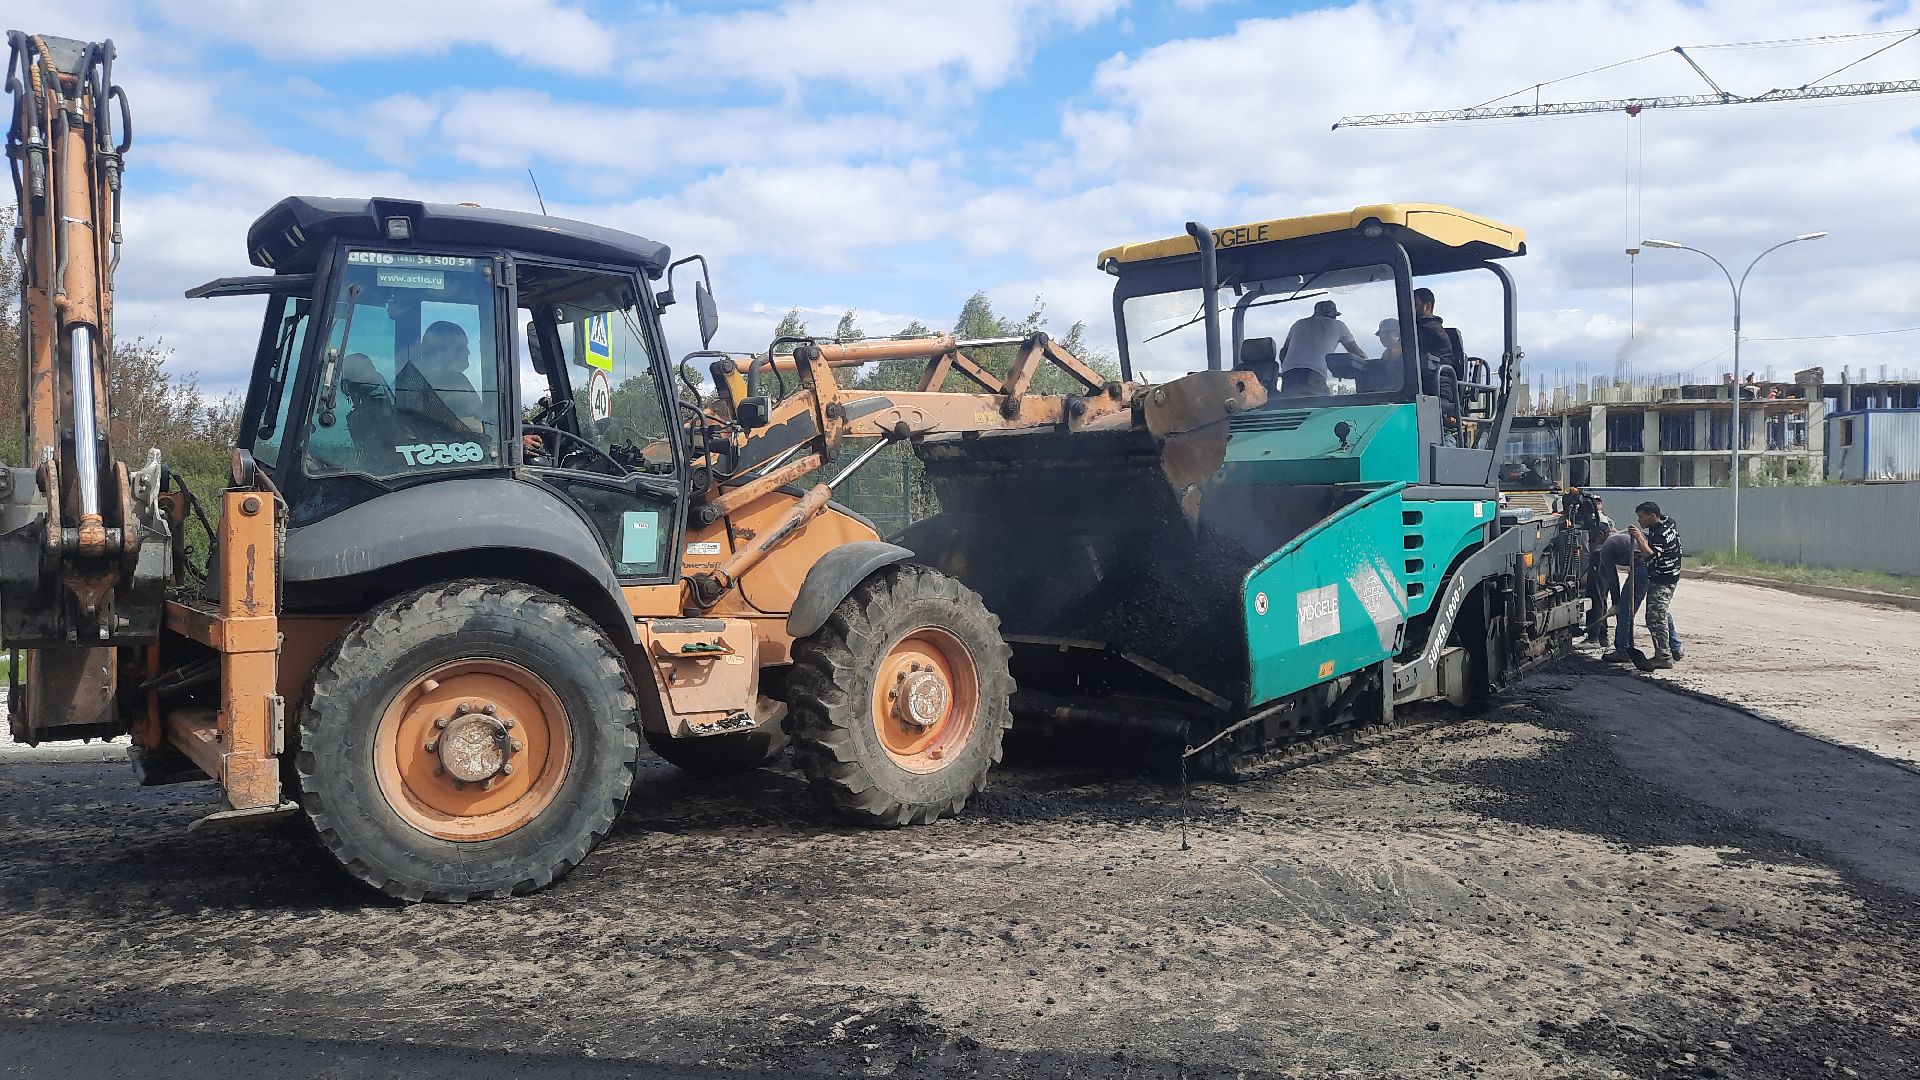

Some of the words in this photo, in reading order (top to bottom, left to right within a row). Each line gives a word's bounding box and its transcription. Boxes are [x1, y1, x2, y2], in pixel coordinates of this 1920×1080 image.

[1194, 224, 1269, 251] ÖGELE
[417, 254, 432, 265] 54
[434, 256, 456, 266] 500
[379, 274, 443, 285] www.actio.ru
[595, 389, 606, 416] 40
[1428, 623, 1448, 671] SUPER
[1445, 575, 1465, 624] 1800-2
